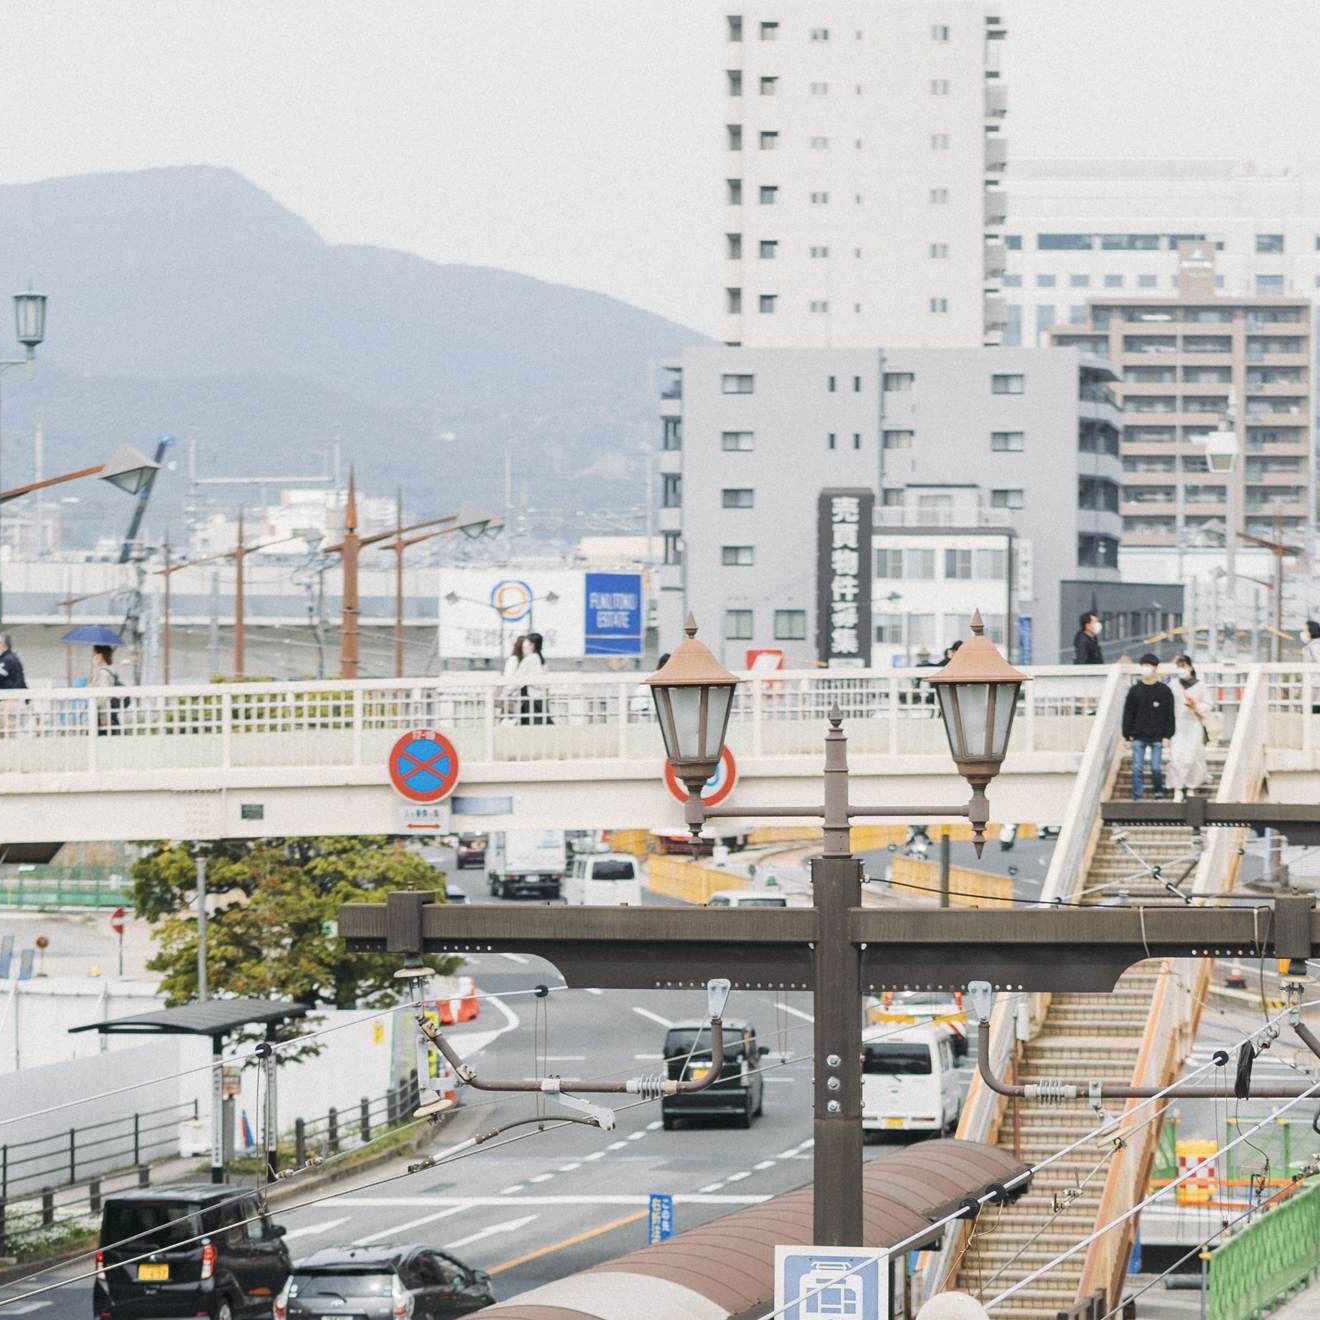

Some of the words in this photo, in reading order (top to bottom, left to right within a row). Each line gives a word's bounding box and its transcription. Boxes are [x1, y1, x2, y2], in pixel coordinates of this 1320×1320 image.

[831, 496, 860, 654] 売買物件募集
